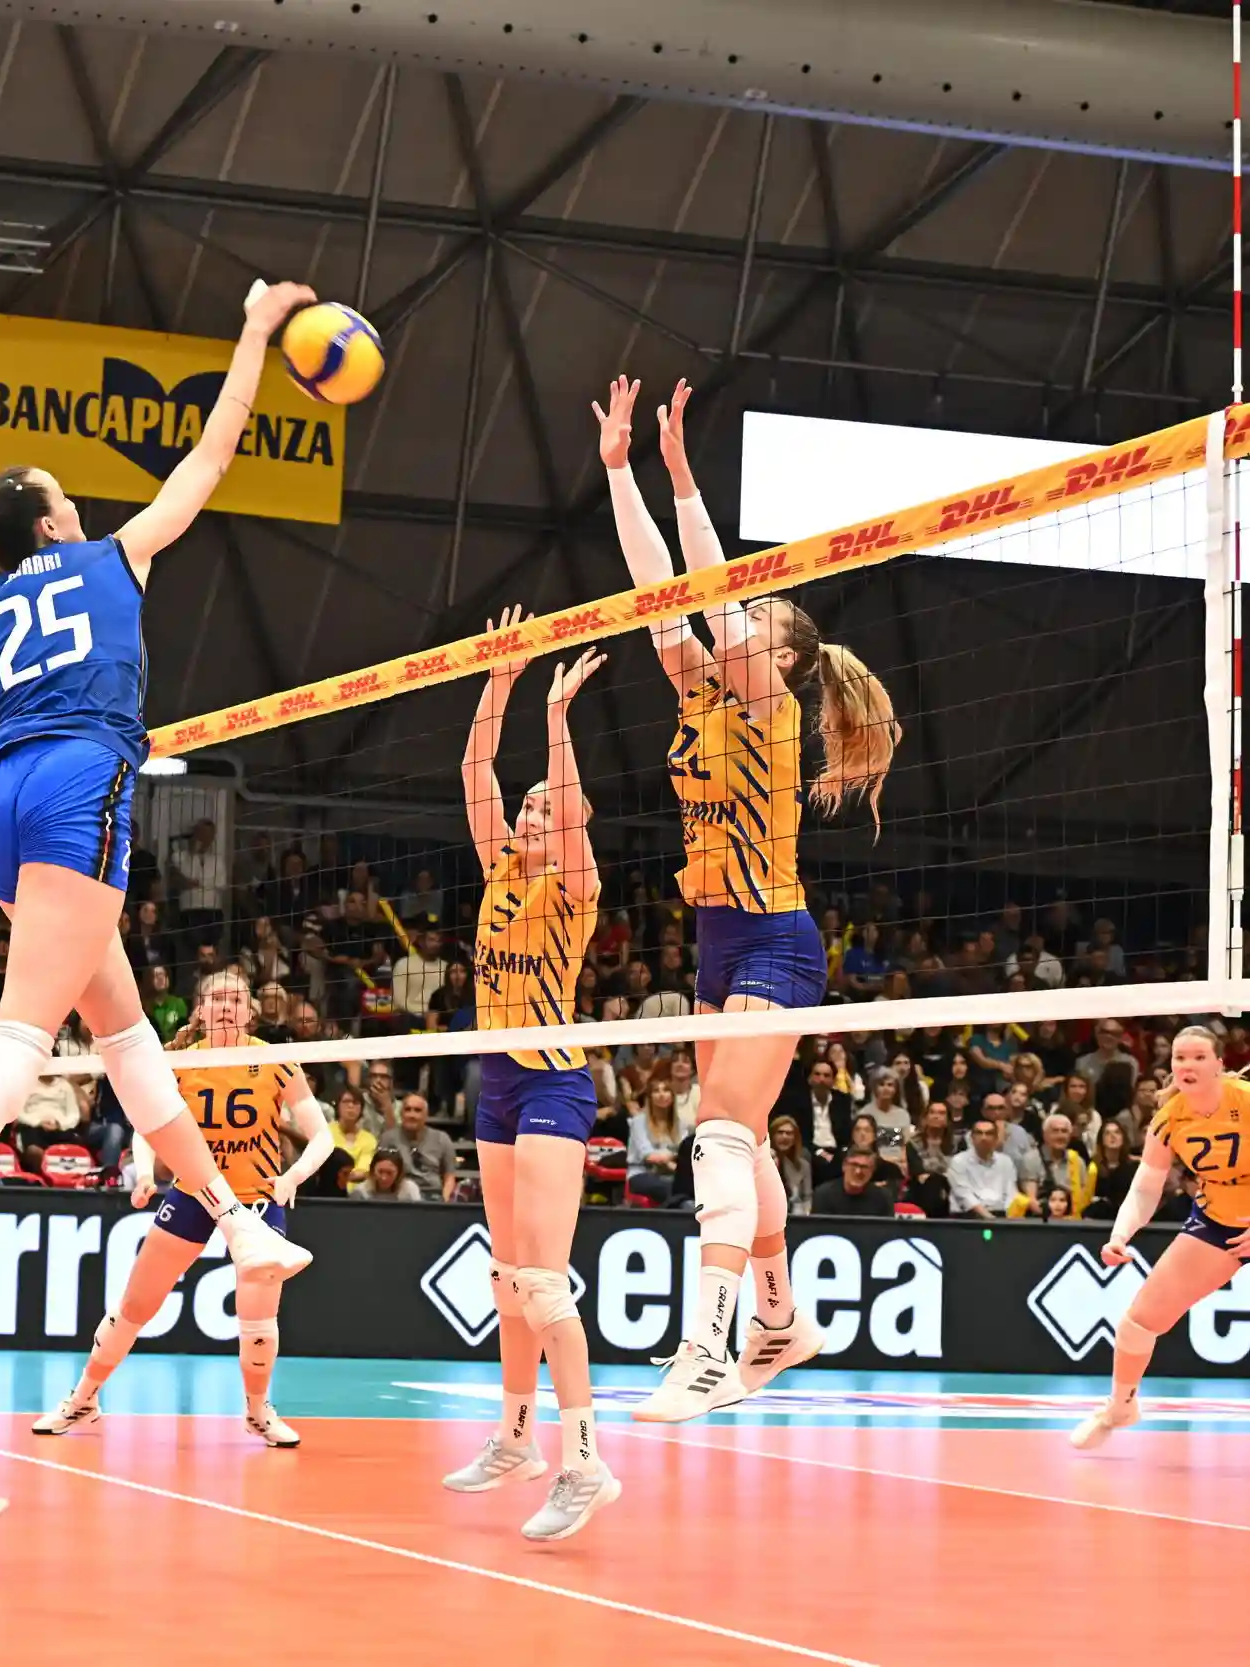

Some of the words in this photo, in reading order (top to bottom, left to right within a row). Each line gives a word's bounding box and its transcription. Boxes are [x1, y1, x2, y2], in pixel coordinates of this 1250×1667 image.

[1064, 445, 1151, 497] DHL
[938, 485, 1021, 533] DHL
[827, 520, 901, 564] DHL
[4, 553, 62, 588] RARI
[726, 551, 793, 592] DHL
[634, 580, 694, 616] DHL
[549, 608, 606, 642] DHL
[197, 1088, 258, 1129] 16
[1186, 1132, 1240, 1172] 27
[765, 1270, 778, 1297] CRAFT
[716, 1285, 728, 1322] CRAFT
[517, 1404, 528, 1428] CRAFT
[579, 1420, 588, 1447] CRAFT
